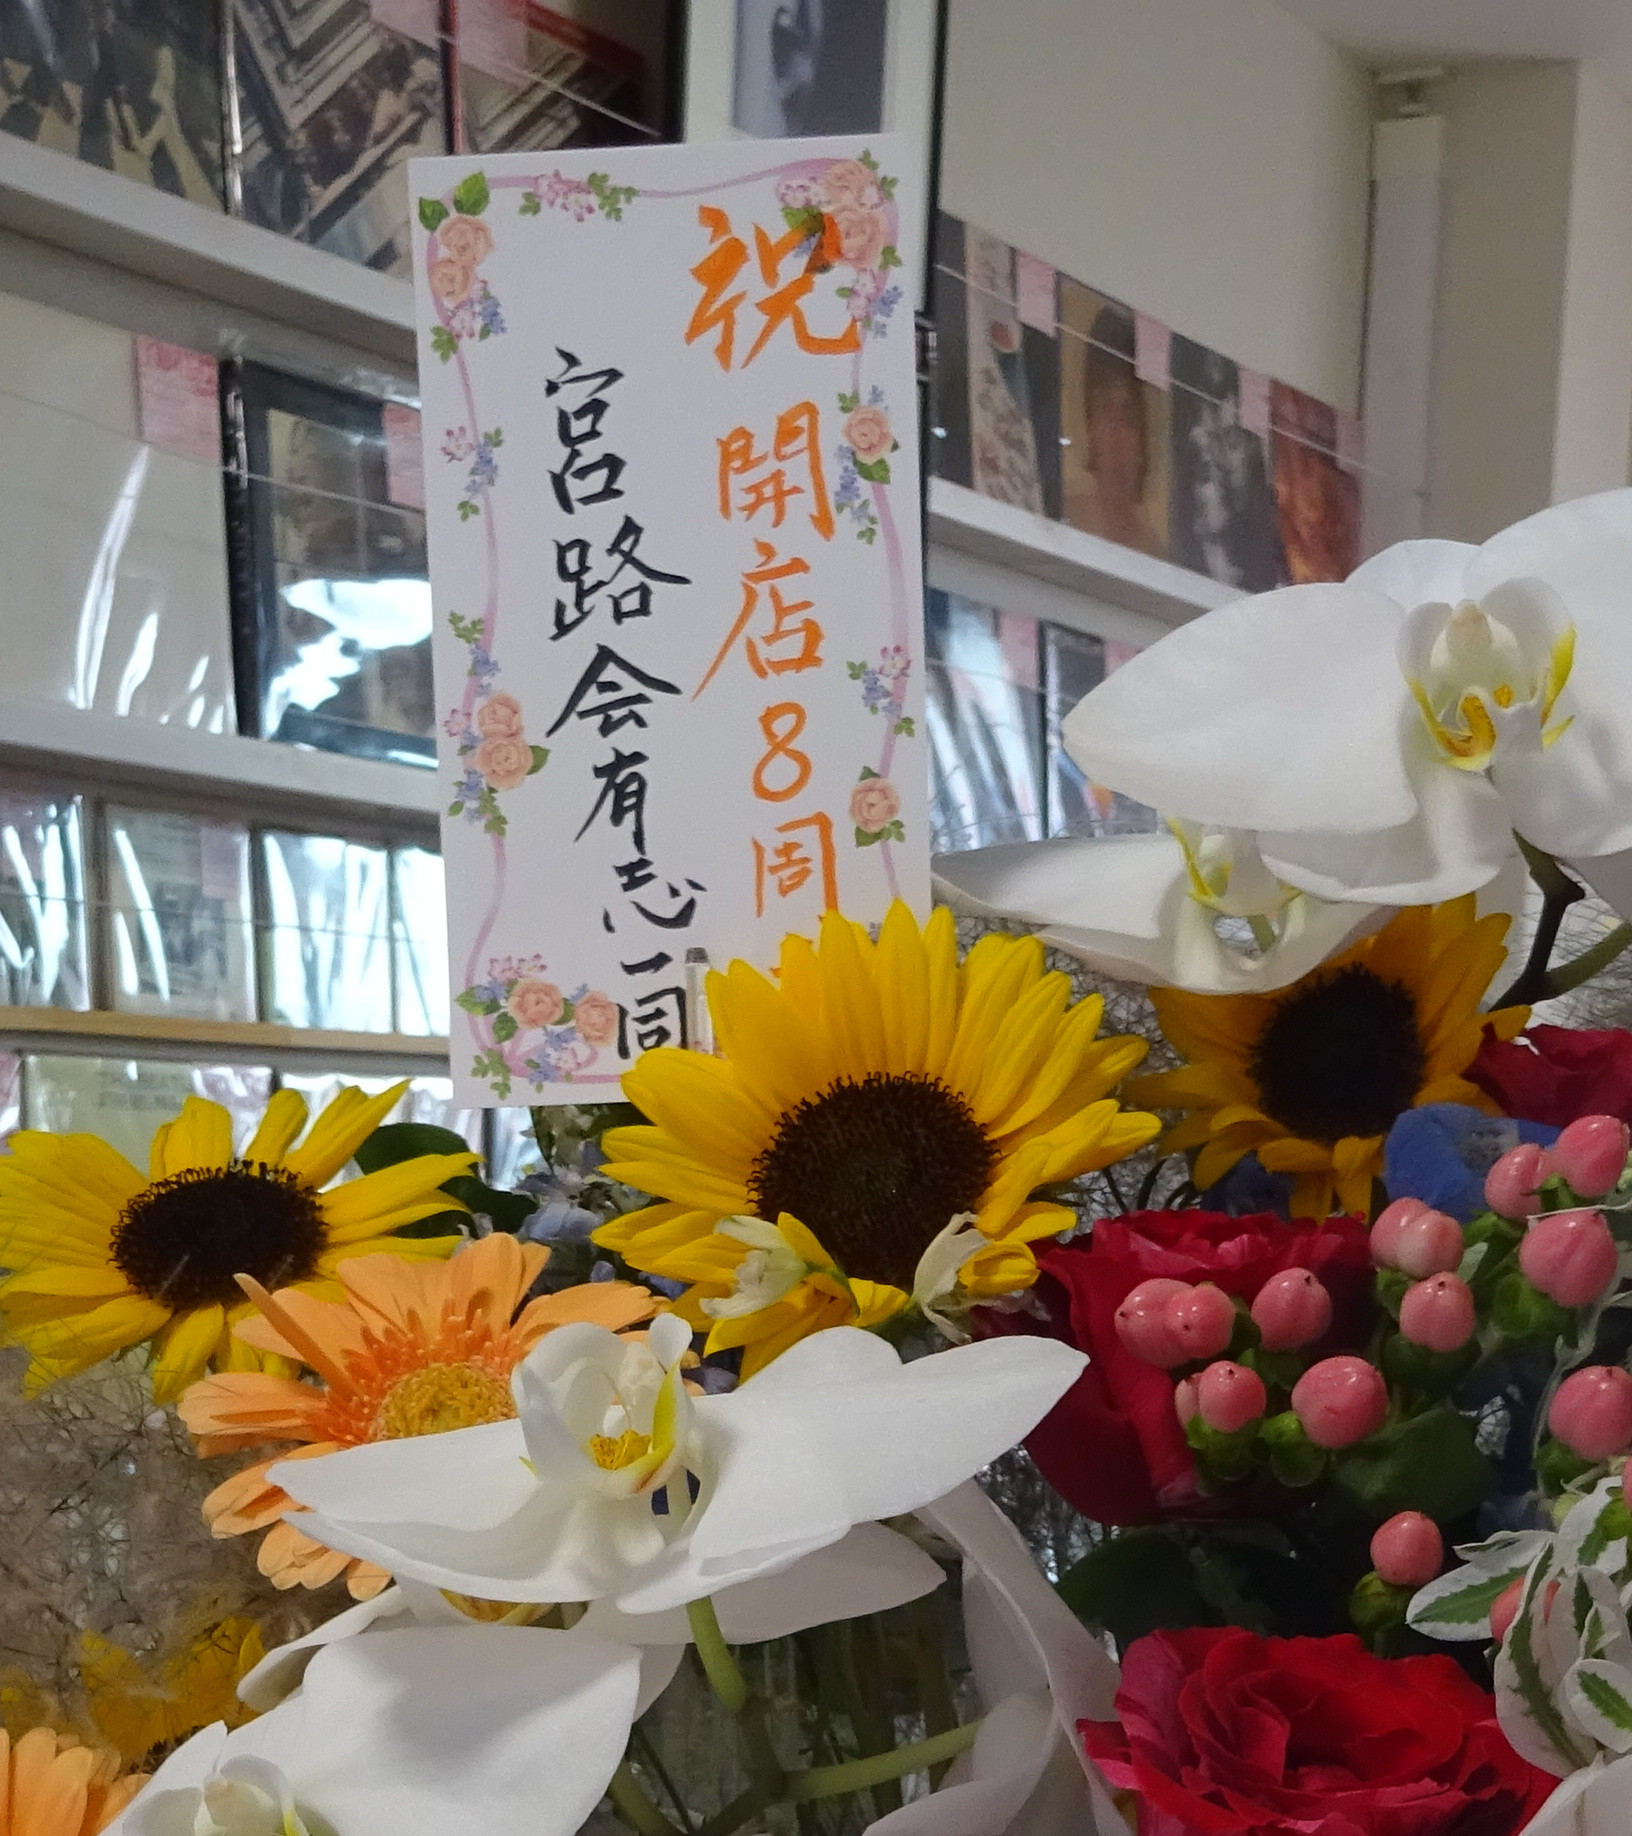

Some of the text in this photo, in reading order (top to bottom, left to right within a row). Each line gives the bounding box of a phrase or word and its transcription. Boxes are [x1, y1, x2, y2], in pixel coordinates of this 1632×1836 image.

[684, 204, 863, 373] 祝
[690, 399, 840, 978] 開店8周
